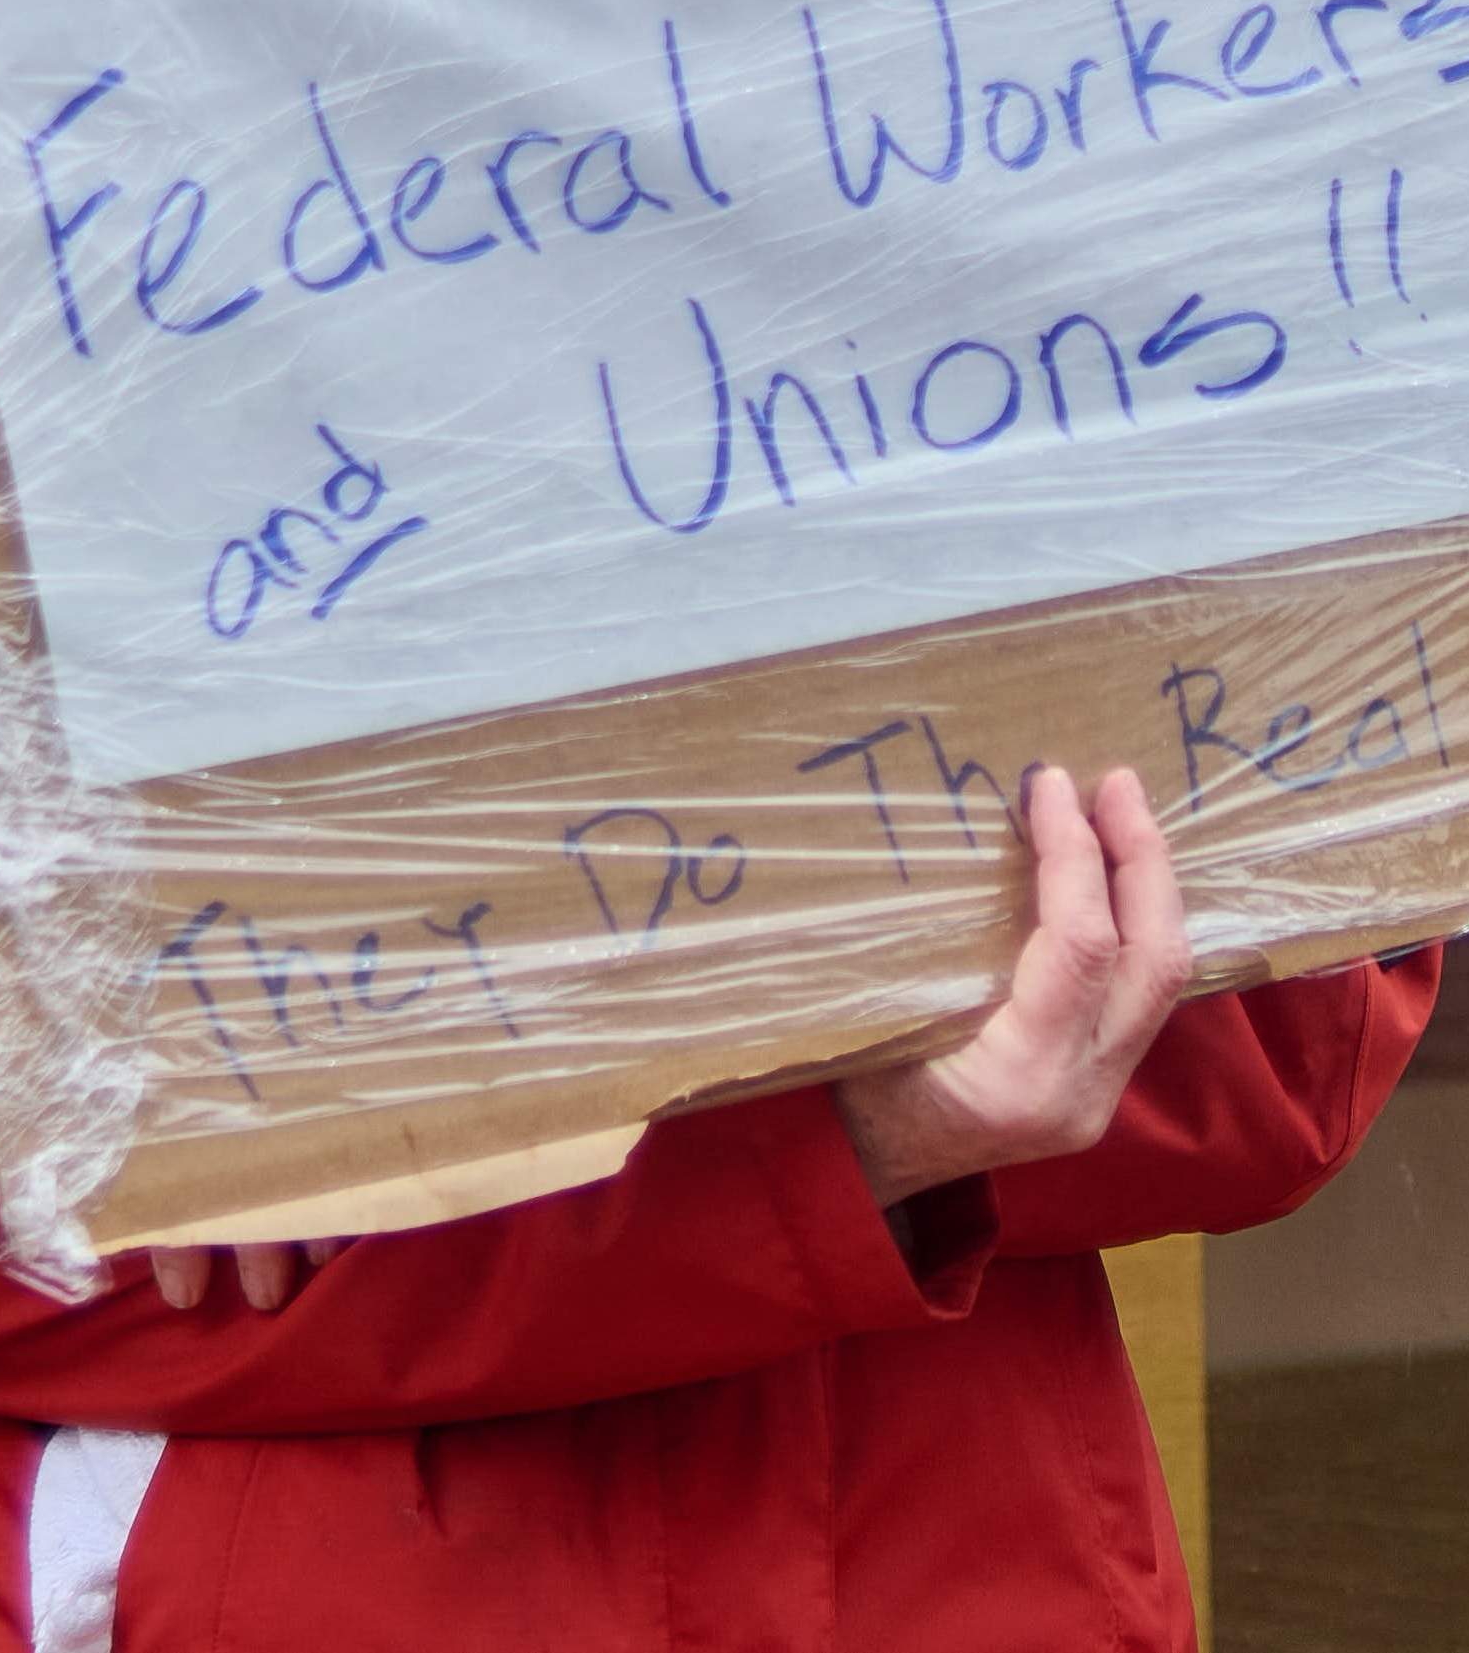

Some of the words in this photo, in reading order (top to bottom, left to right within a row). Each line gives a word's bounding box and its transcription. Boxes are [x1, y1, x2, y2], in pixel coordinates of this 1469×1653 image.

[25, 19, 731, 358] Federal
[206, 423, 393, 640] and
[599, 168, 1428, 533] Unions!!
[561, 807, 748, 954] Do
[1163, 619, 1451, 813] Real
